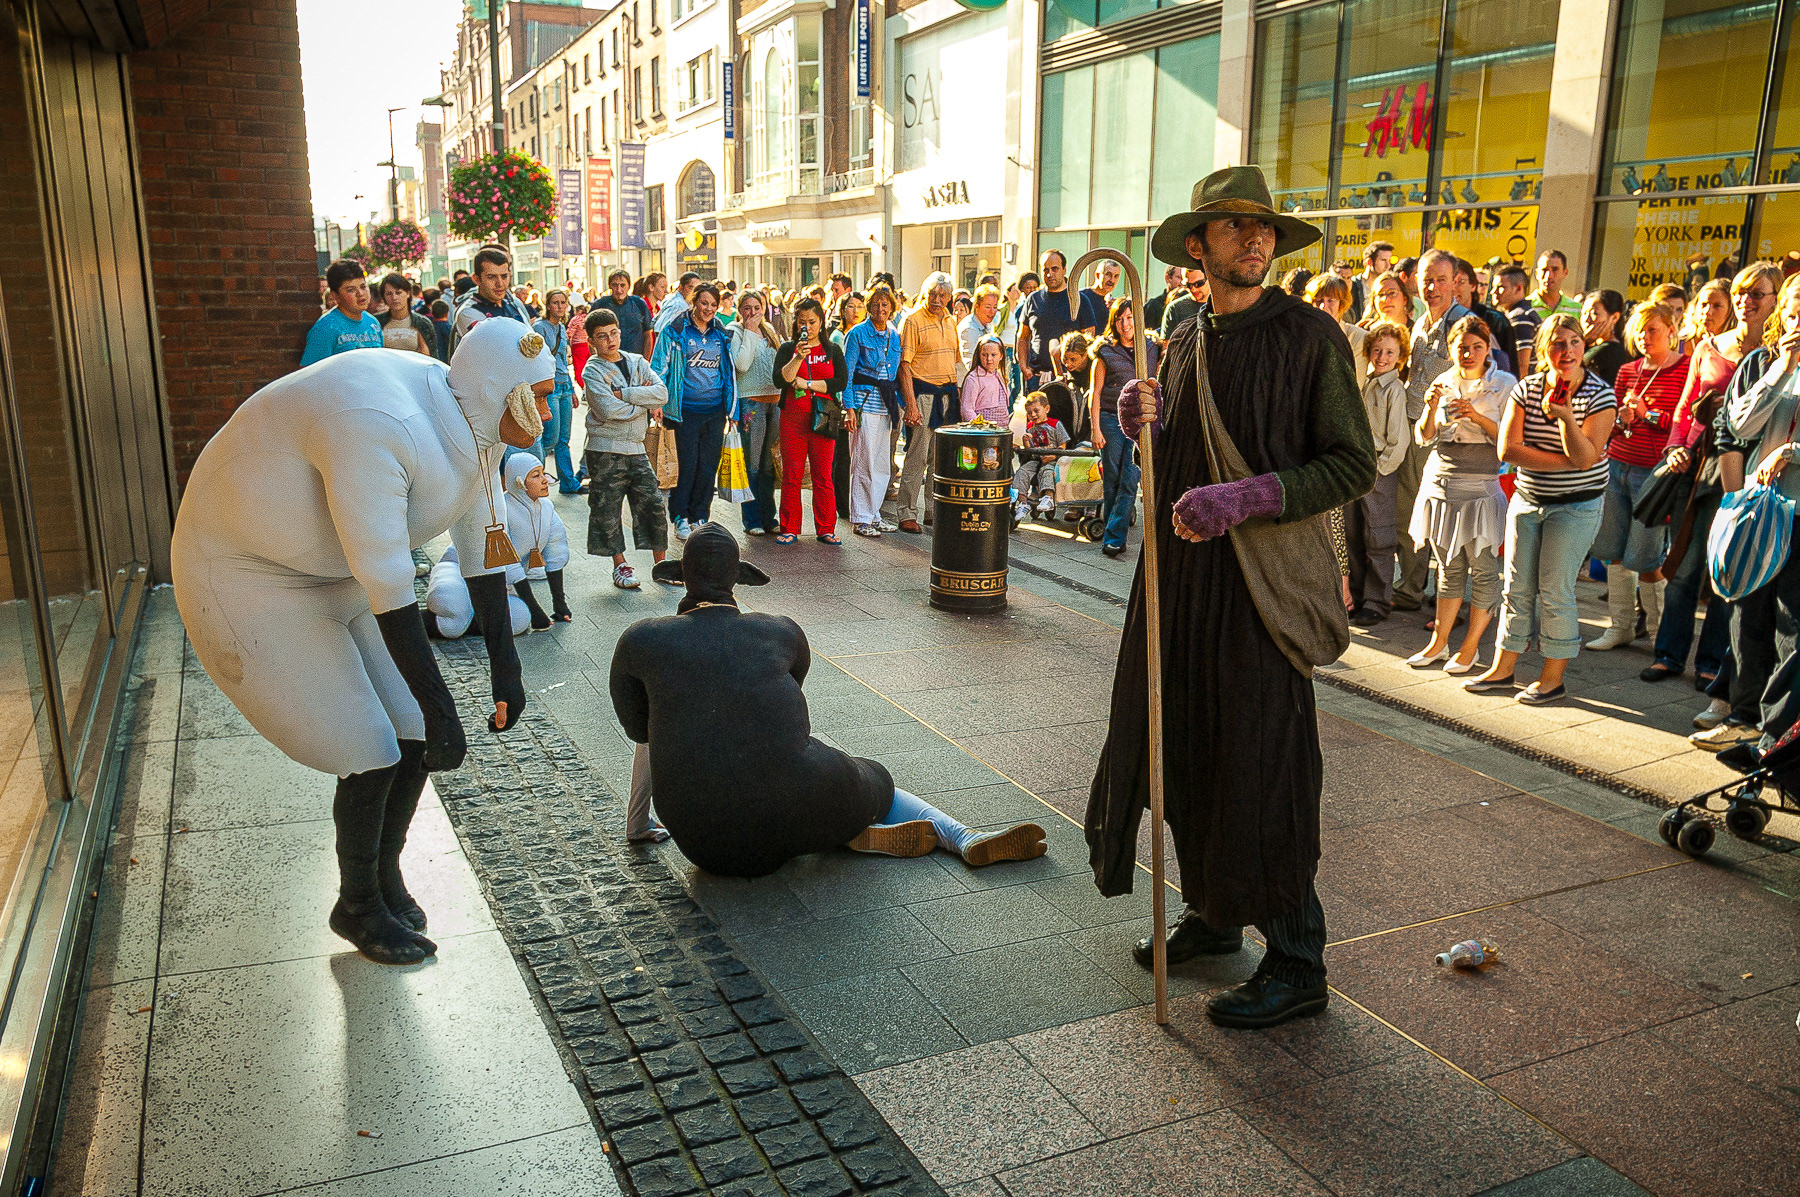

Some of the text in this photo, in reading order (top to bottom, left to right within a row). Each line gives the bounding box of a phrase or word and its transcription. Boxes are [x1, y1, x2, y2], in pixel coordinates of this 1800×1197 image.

[859, 6, 869, 85] LIFESTYLE SPORTS
[1335, 232, 1368, 246] PARIS
[1645, 225, 1694, 242] YORK
[950, 486, 1004, 499] LITTER
[939, 576, 1005, 591] BRUSCAR
